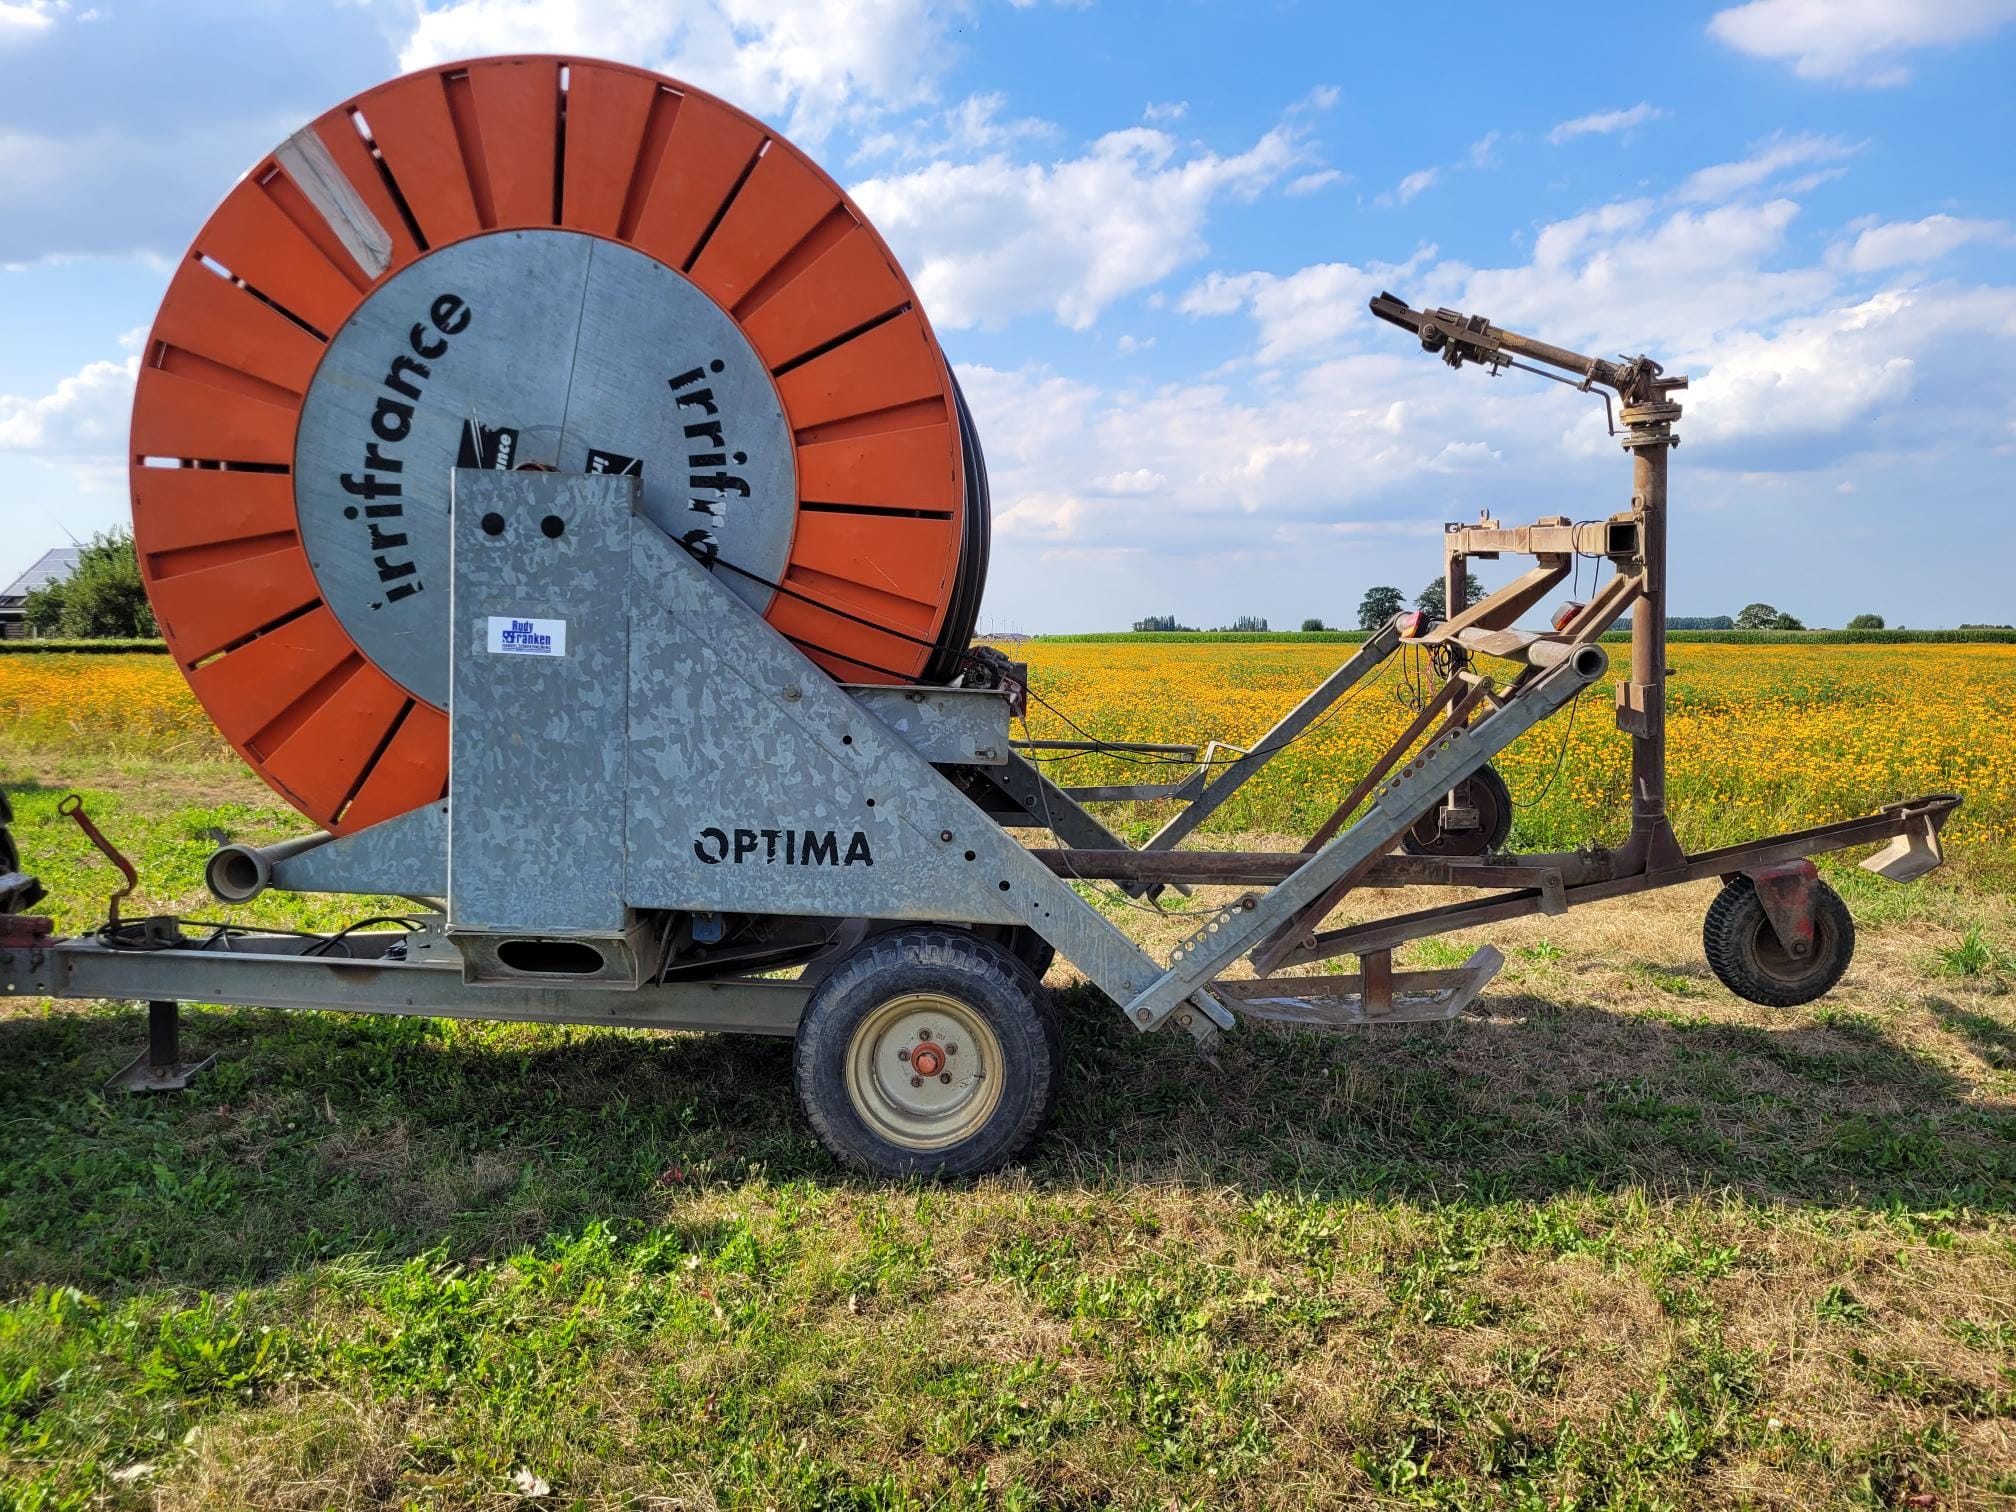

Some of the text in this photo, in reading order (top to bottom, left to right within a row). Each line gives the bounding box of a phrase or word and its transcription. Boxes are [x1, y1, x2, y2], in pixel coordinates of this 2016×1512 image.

[340, 293, 472, 611] irrifrance
[668, 359, 751, 572] irrifra
[512, 620, 534, 632] Rudy
[693, 827, 874, 866] OPTIMA
